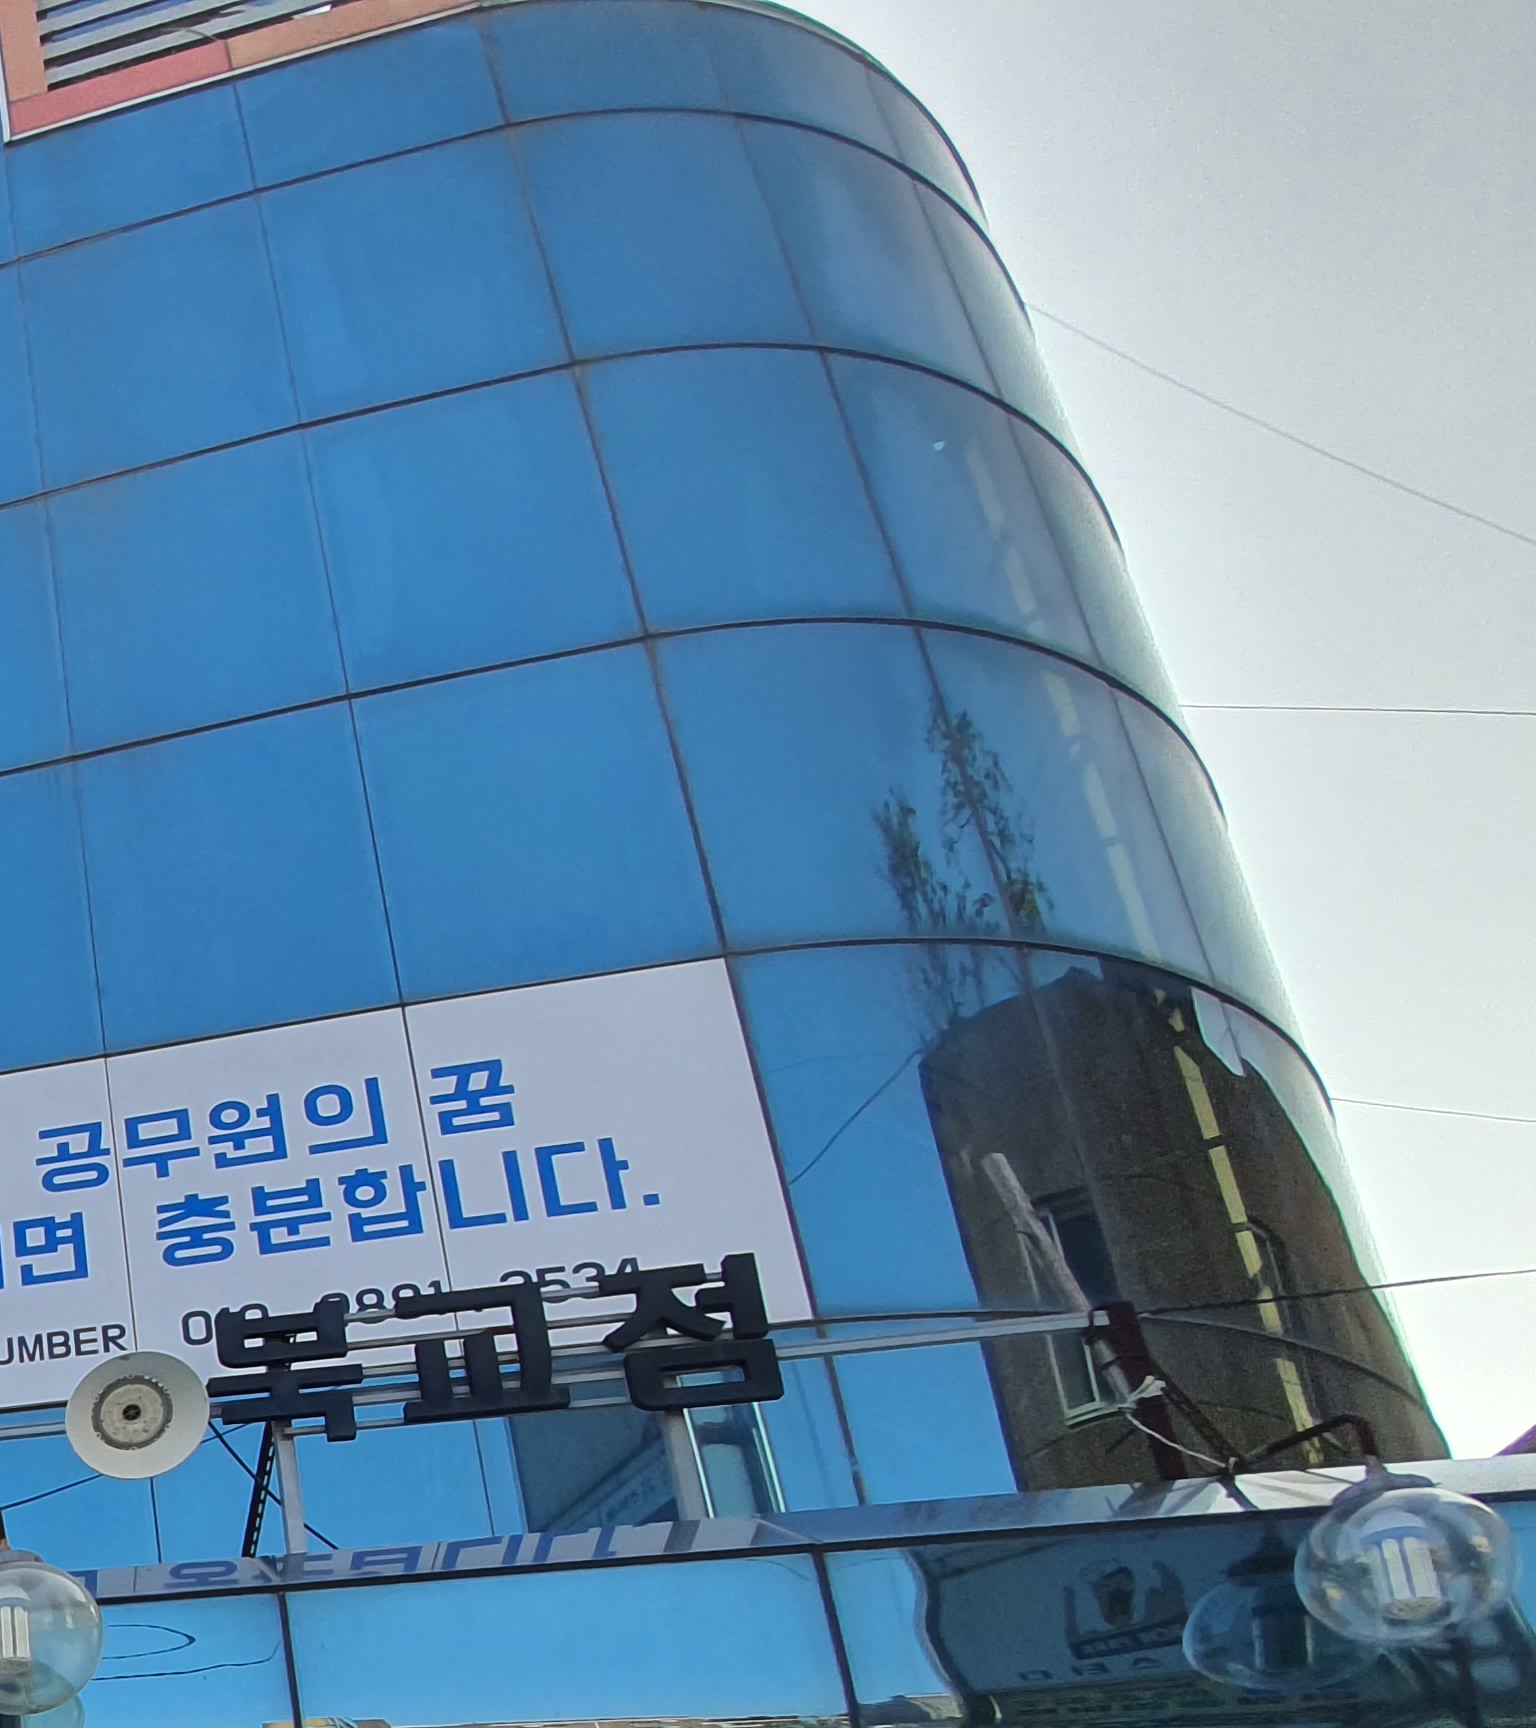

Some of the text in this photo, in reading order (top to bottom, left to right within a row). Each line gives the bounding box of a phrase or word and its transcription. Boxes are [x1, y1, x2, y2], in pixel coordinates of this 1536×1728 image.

[35, 1075, 389, 1195] 공무원의
[428, 1058, 517, 1137] 꿈
[153, 1138, 661, 1267] 충분합니다.
[207, 1253, 785, 1441] 북교점
